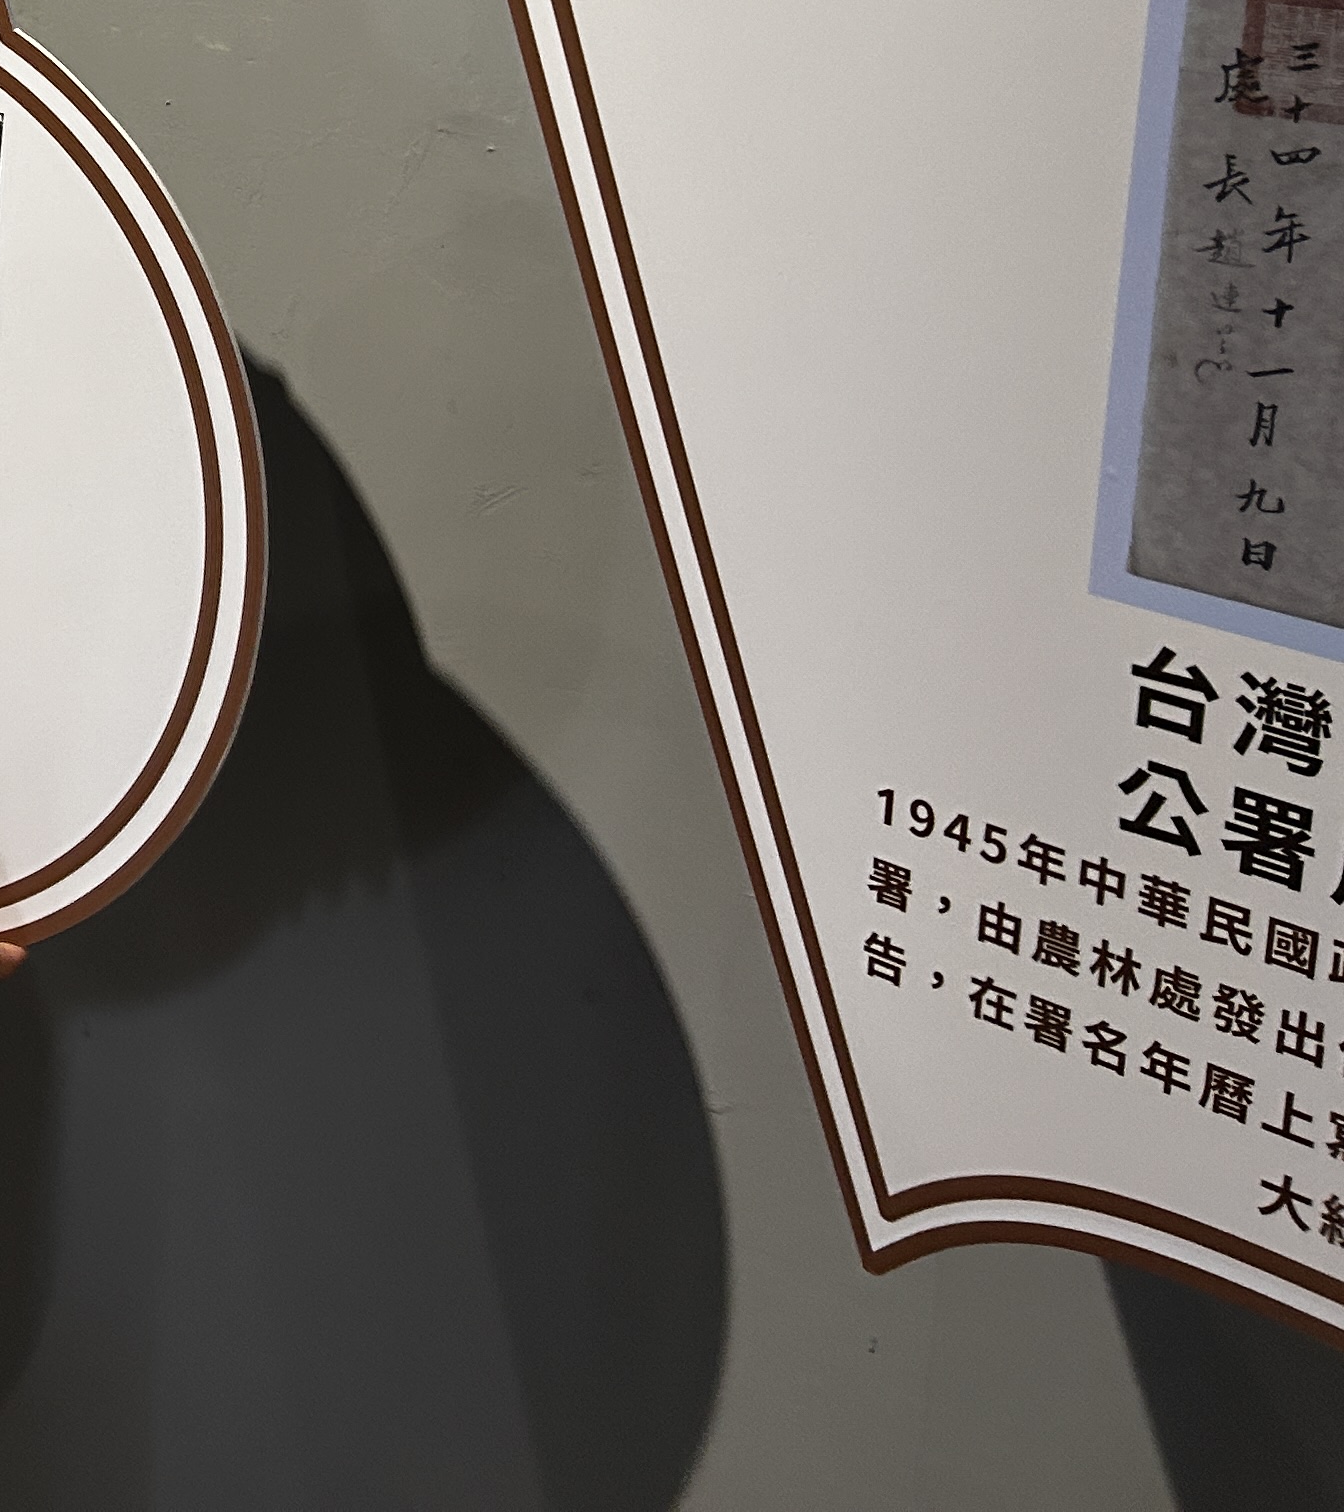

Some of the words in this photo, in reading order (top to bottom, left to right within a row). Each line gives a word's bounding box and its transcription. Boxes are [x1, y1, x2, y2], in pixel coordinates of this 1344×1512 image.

[1131, 646, 1333, 777] 台灣
[1118, 760, 1344, 905] 公署
[868, 858, 1344, 1071] 署，由農林處發出
